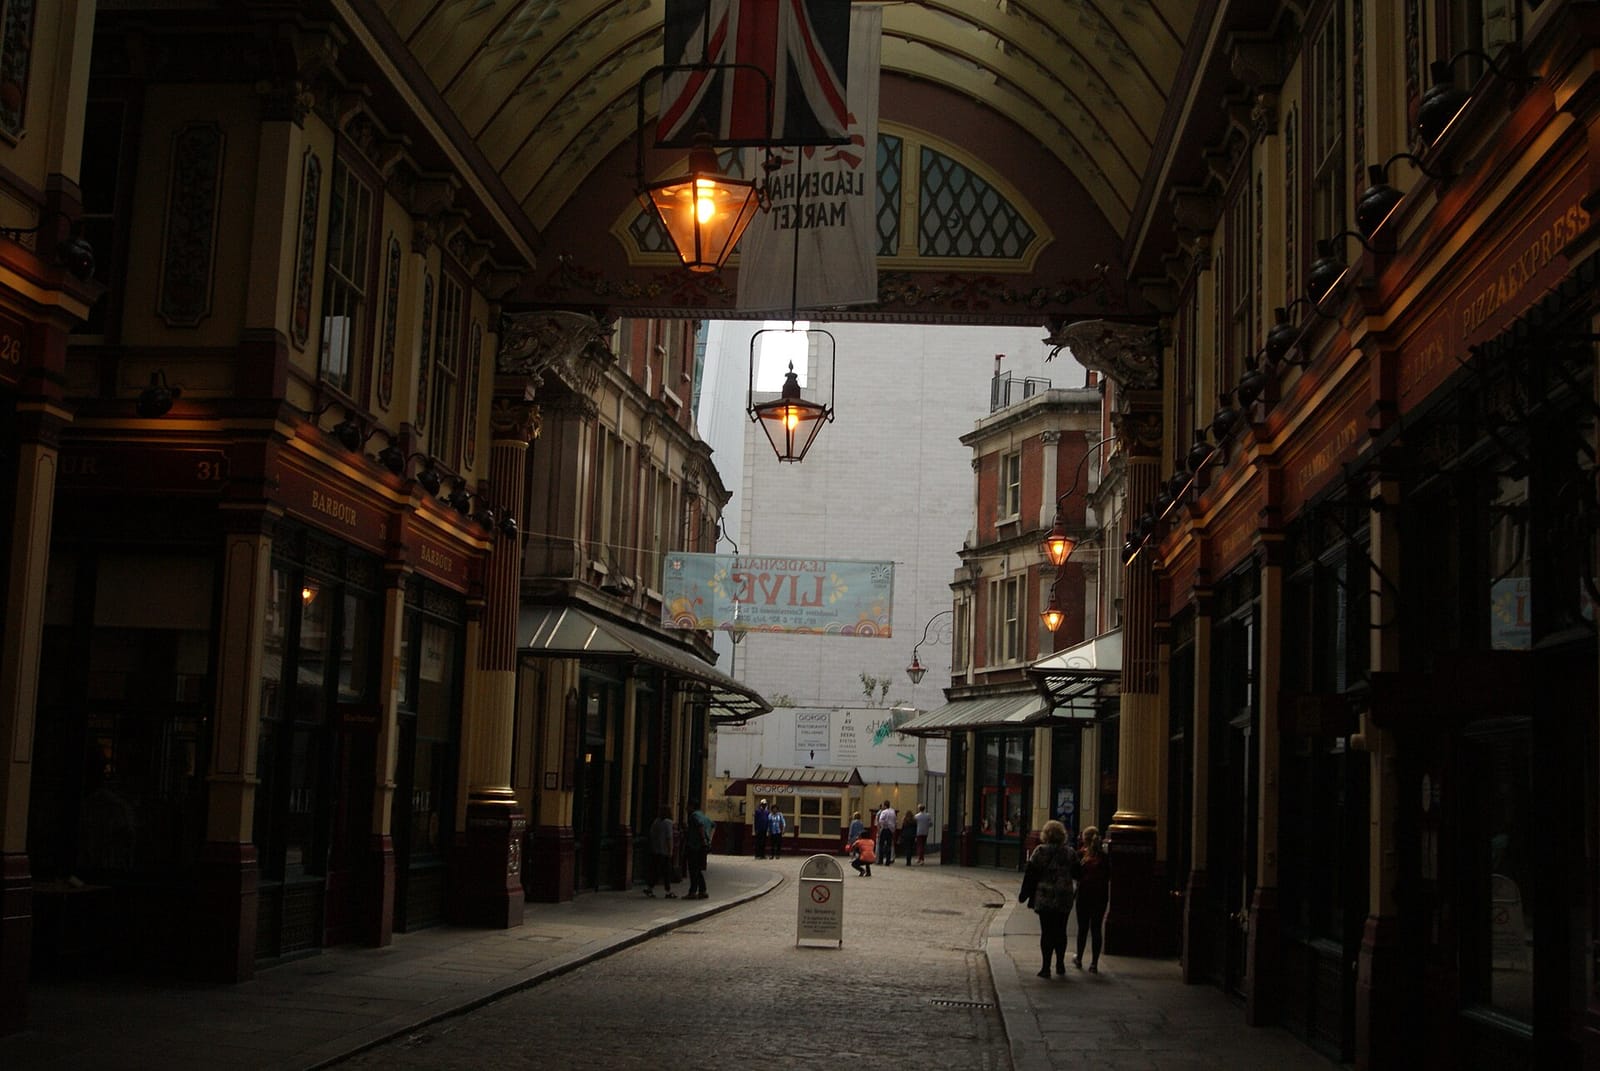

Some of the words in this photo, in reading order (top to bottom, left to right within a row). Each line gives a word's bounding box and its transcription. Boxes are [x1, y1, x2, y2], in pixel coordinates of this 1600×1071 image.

[1, 334, 22, 365] 26
[195, 459, 221, 481] 31
[311, 490, 358, 527] BARBOUR
[754, 784, 794, 794] GIORGIO
